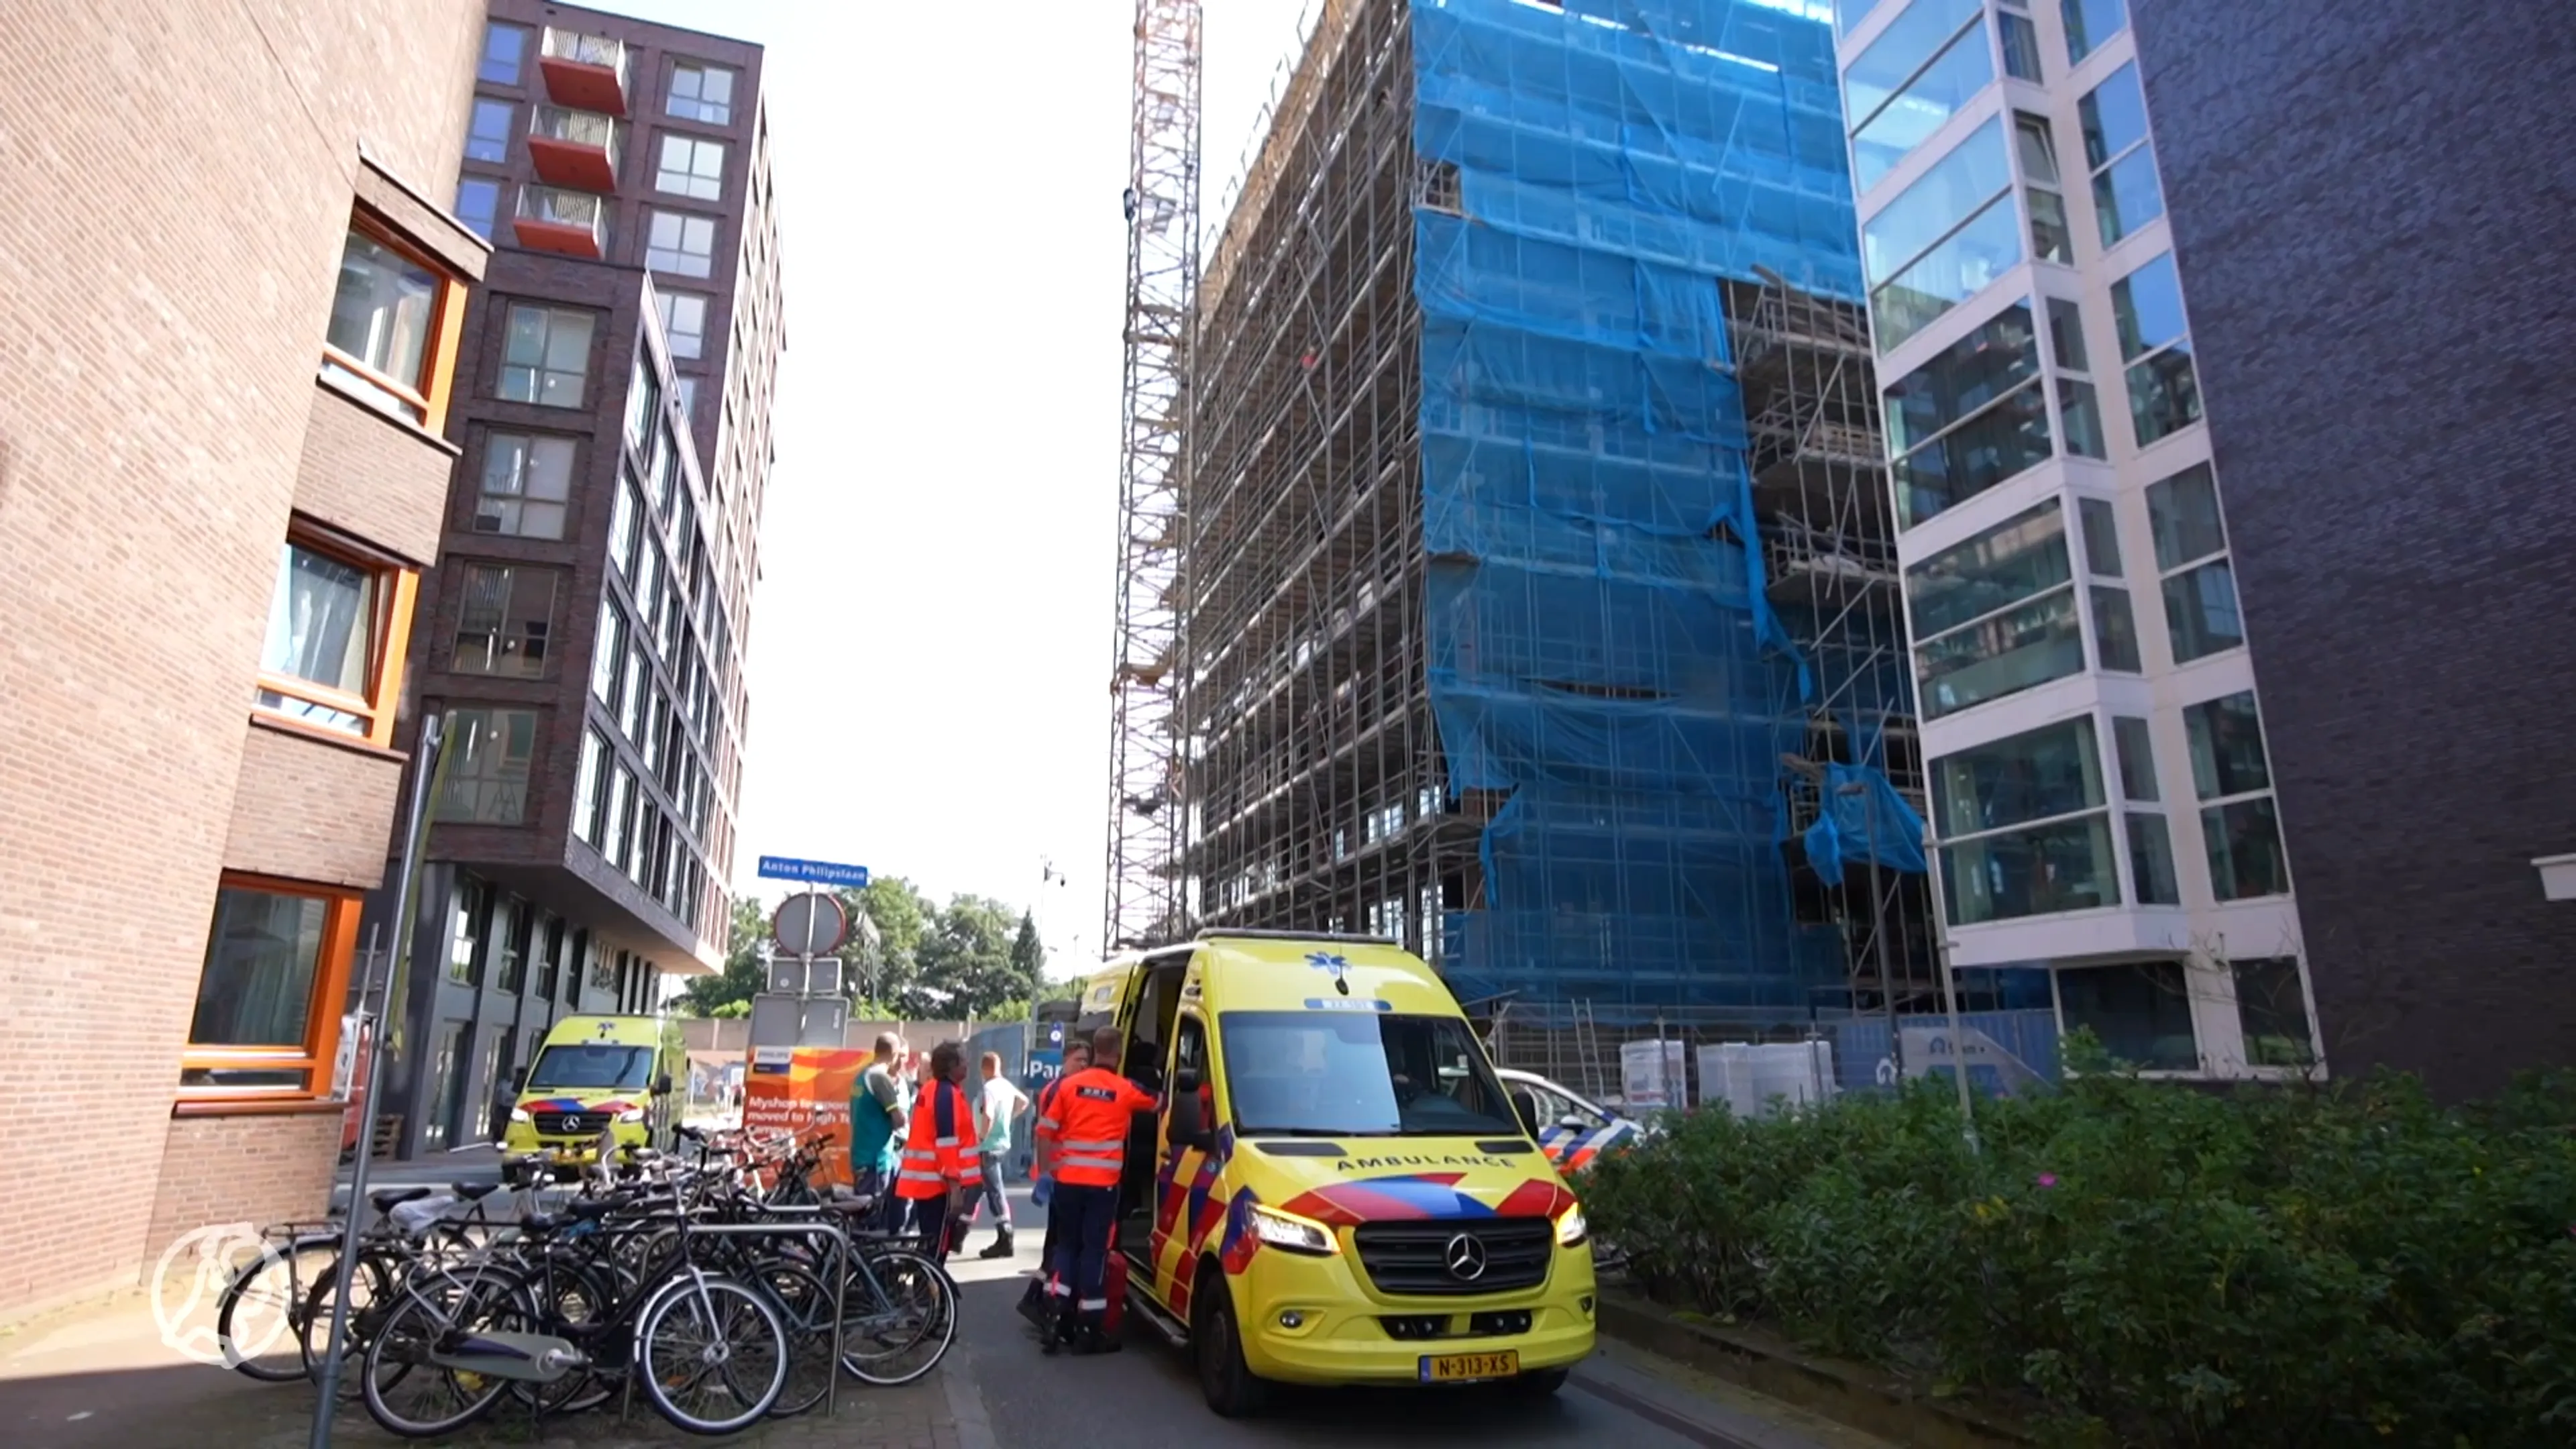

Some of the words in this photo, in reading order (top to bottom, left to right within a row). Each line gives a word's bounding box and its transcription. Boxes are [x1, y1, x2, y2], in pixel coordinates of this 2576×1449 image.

[762, 859, 799, 873] Anton
[802, 863, 865, 880] Philipslaan
[747, 1111, 789, 1122] moved
[792, 1112, 804, 1122] to
[1337, 1155, 1516, 1171] AMBULANCE
[1439, 1354, 1509, 1376] N-313-XS
